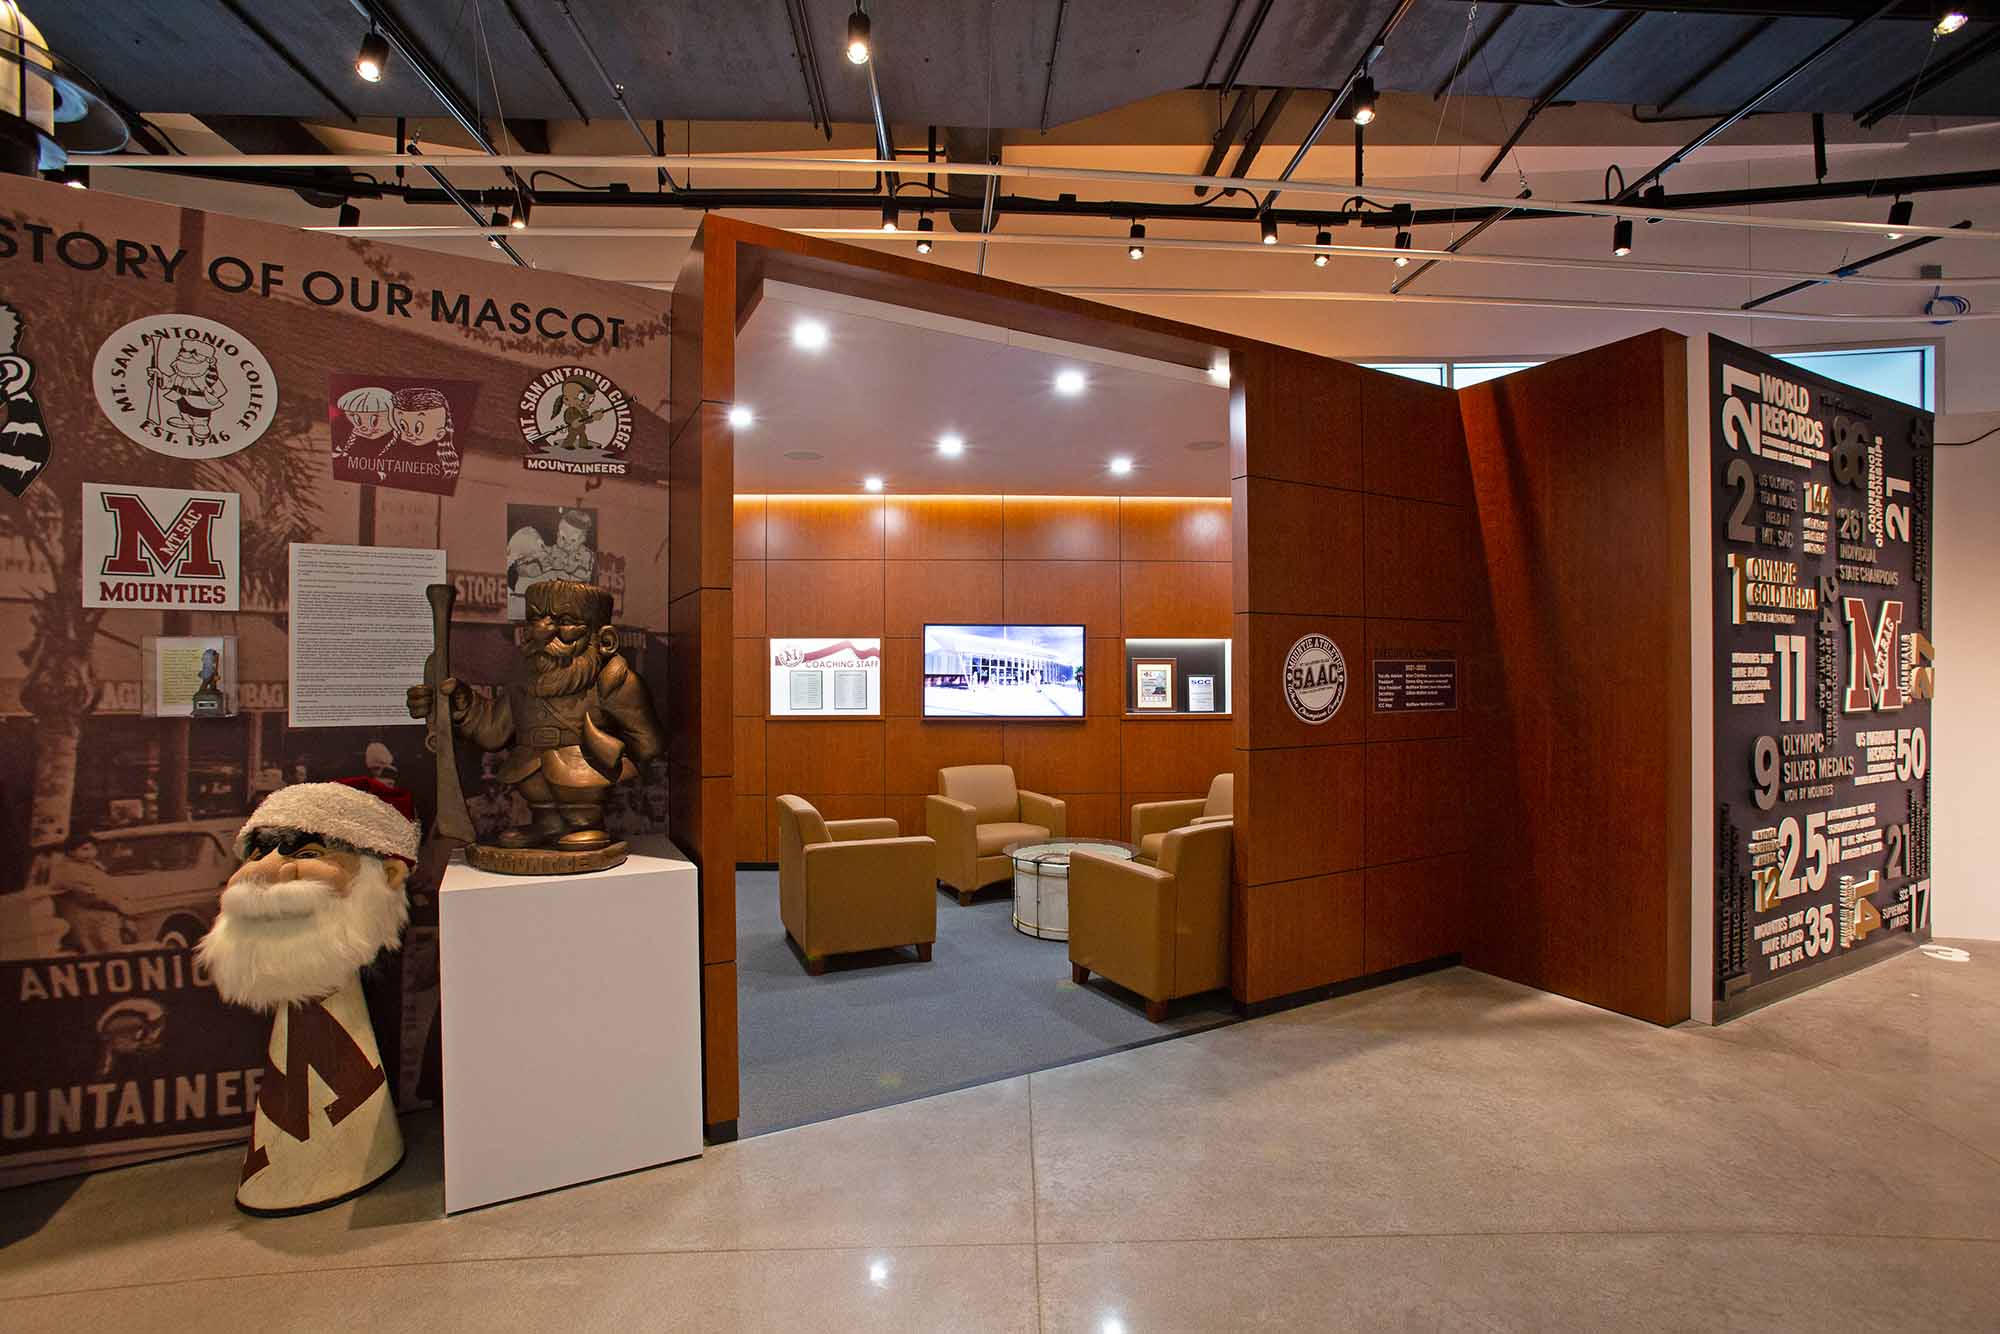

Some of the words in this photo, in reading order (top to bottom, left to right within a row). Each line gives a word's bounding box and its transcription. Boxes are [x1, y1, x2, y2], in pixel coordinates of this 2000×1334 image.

[207, 255, 284, 297] OF
[302, 270, 413, 318] OUR
[431, 289, 625, 347] MASCOT
[141, 327, 239, 356] ANTONIO
[112, 343, 139, 378] SAN
[112, 383, 136, 413] MT.
[237, 359, 263, 431] COLLEGE
[520, 381, 545, 411] SAN
[1761, 373, 1809, 414] WORLD
[140, 421, 178, 444] EST.
[187, 430, 231, 446] 1946
[520, 415, 541, 444] MT.
[1762, 403, 1824, 448] RECORDS
[347, 456, 441, 475] MOUNTAINEERS
[527, 459, 626, 474] MOUNTAINEERS
[1728, 459, 1756, 543] 2
[1868, 447, 1876, 534] CONFERENCE
[1875, 436, 1883, 548] CHAMPIONSHIPS
[1749, 558, 1797, 584] OLYMPIC
[1840, 564, 1860, 582] STATE
[1860, 567, 1898, 585] CHAMPIONS
[100, 581, 226, 604] MOUNTIES
[1749, 582, 1780, 607] GOLD
[805, 660, 854, 669] COACHING
[856, 660, 879, 669] STAFF
[1288, 638, 1313, 670] MOUNTIE
[1293, 663, 1338, 689] SAAC
[1775, 634, 1806, 721] 11
[1783, 732, 1825, 756] OLYMPIC
[1897, 727, 1926, 781] 50
[1755, 735, 1779, 811] 9
[1783, 760, 1816, 784] SILVER
[1819, 755, 1855, 779] MEDALS
[1887, 823, 1911, 880] 21
[1909, 878, 1930, 933] 17
[1804, 903, 1834, 957] 35
